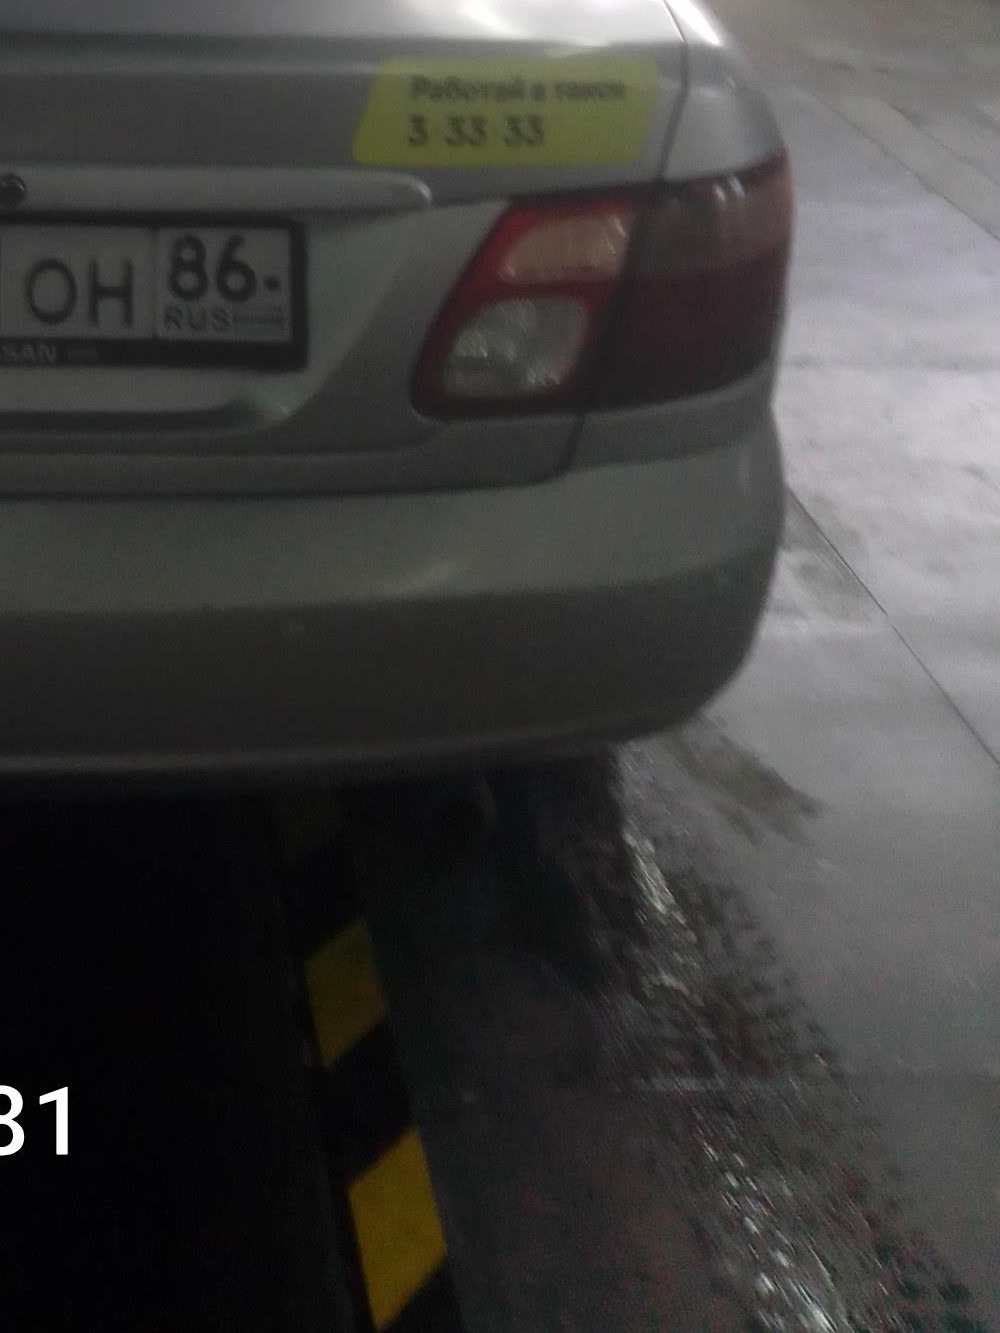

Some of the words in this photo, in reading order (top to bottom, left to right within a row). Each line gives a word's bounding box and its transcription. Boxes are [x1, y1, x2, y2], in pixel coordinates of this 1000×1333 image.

[407, 114, 428, 147] 3
[445, 114, 489, 147] 33
[503, 114, 546, 147] 33
[170, 235, 257, 301] 86
[163, 305, 231, 332] RUS
